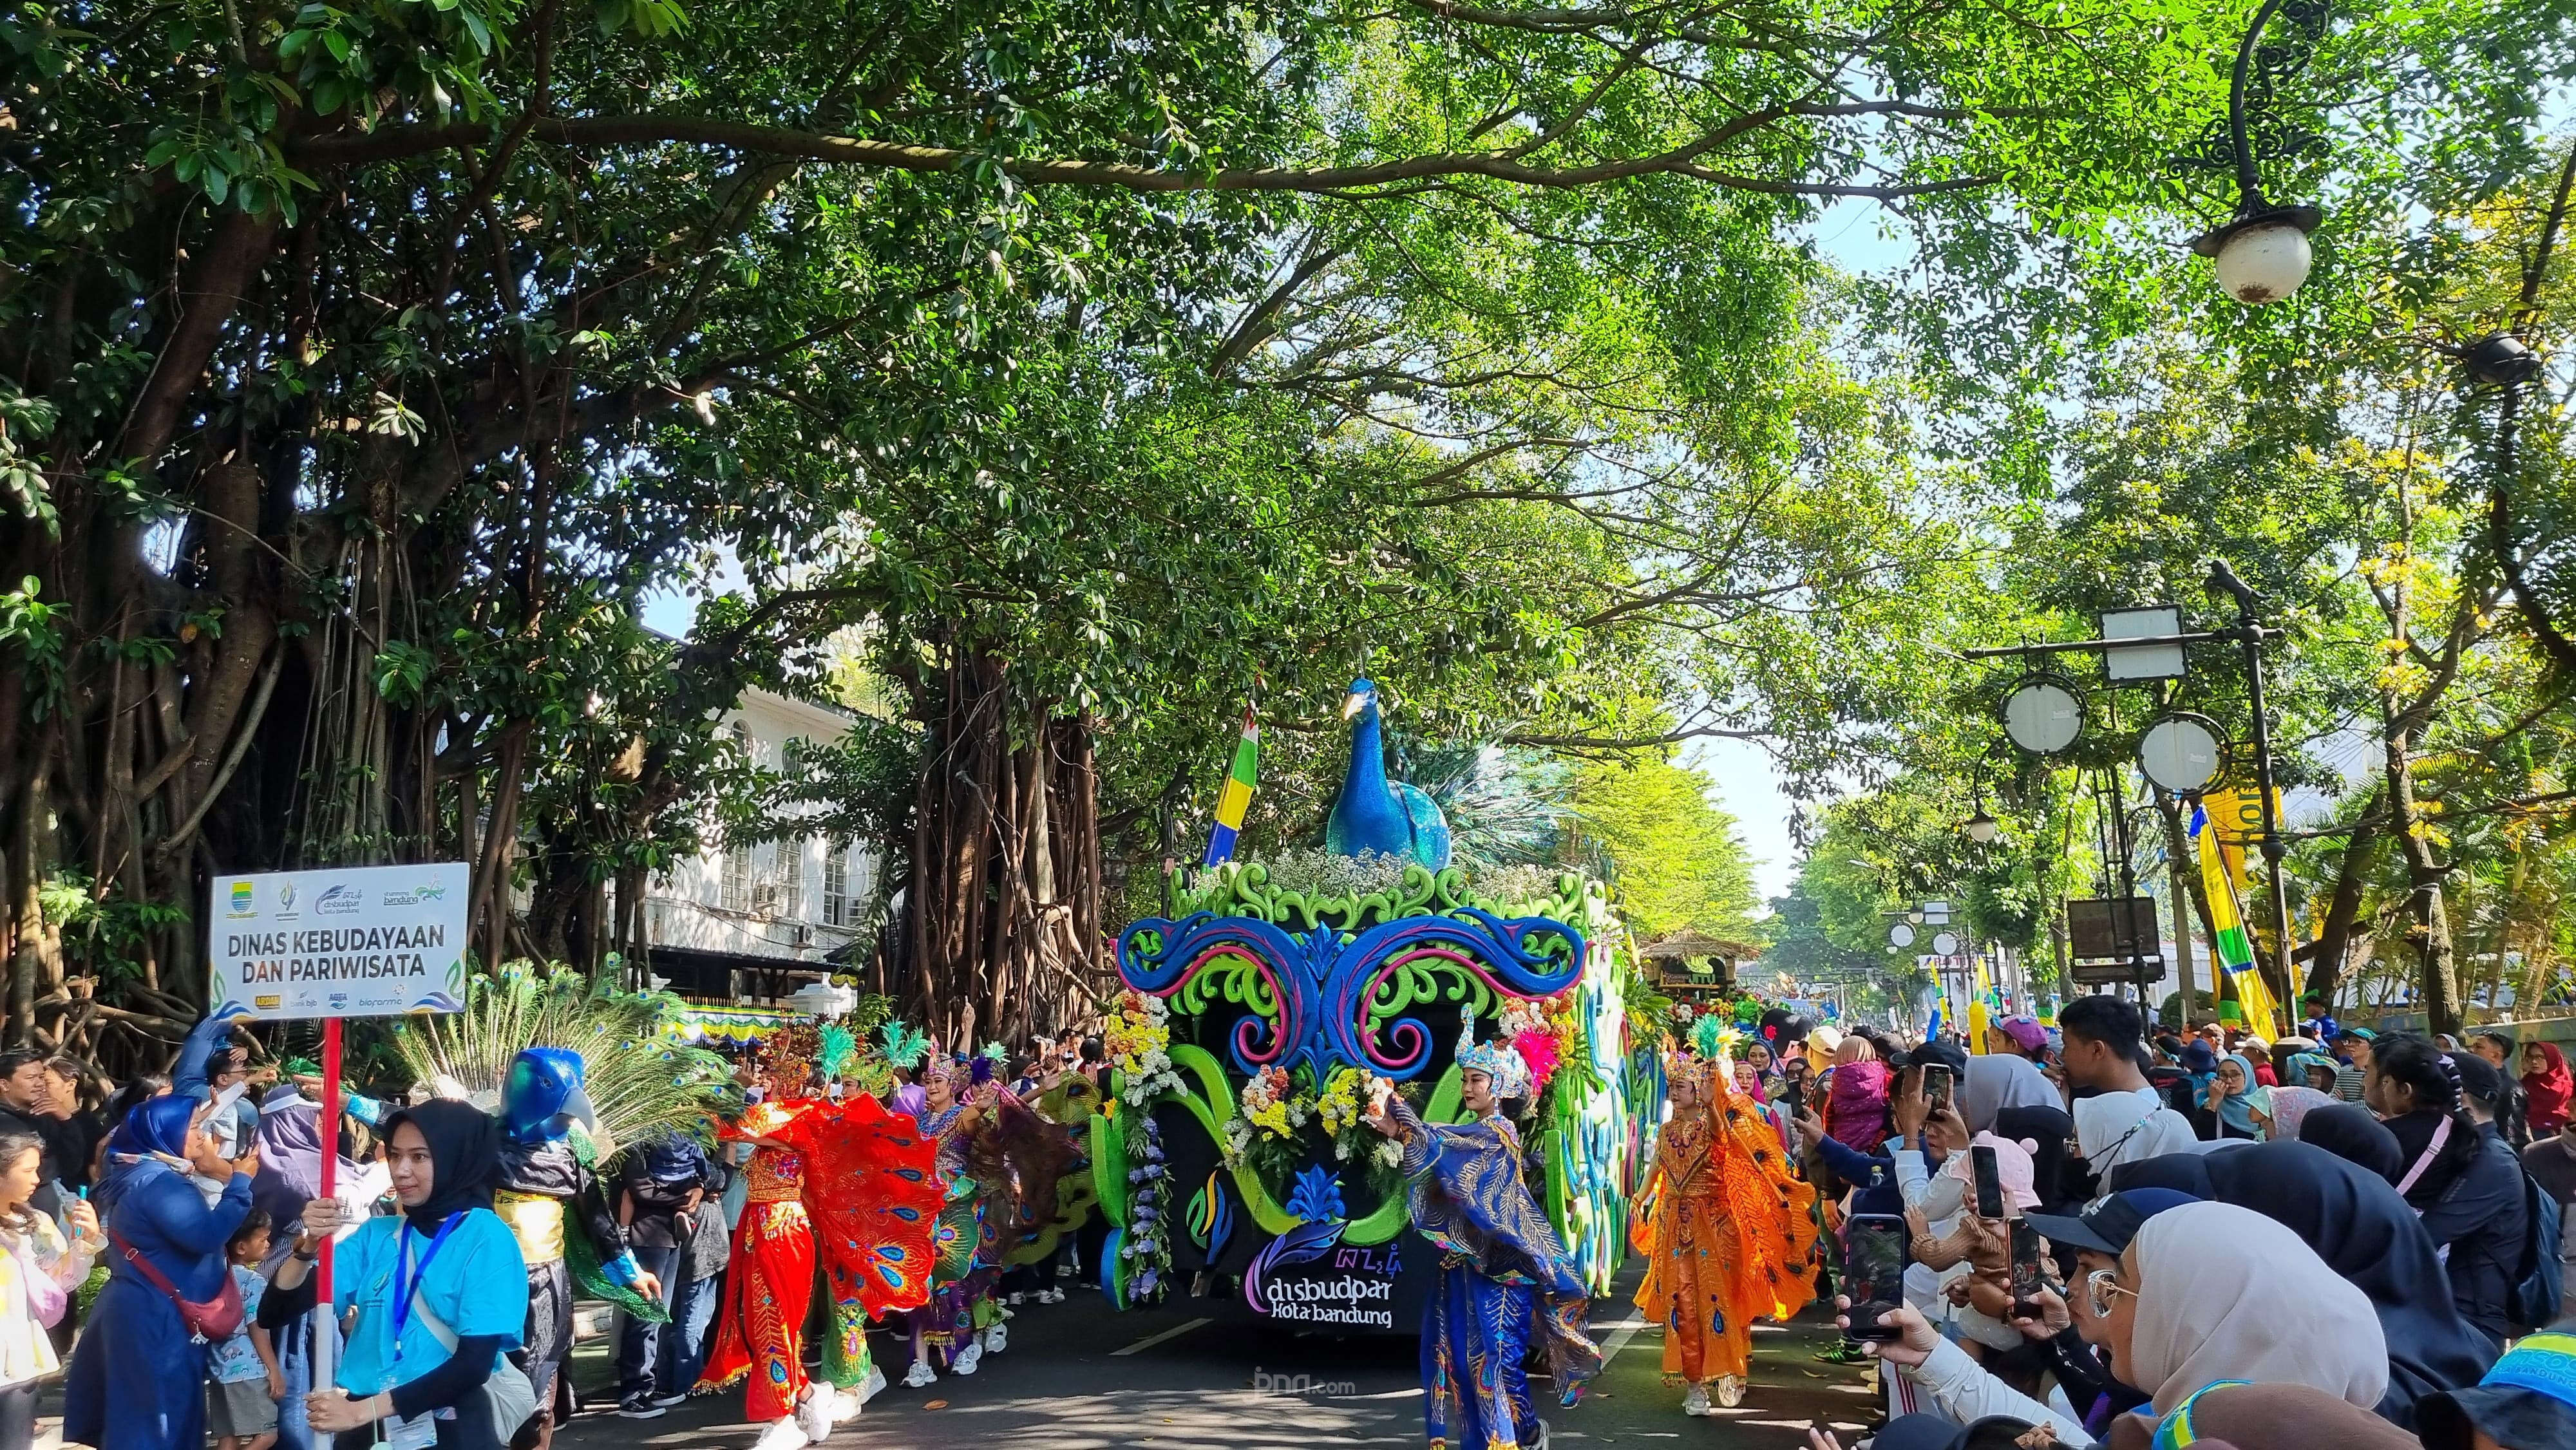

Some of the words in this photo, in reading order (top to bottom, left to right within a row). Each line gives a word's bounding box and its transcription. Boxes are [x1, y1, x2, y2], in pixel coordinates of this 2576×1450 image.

[228, 932, 287, 957] DINAS
[293, 925, 445, 954] KEBUDAYAAN
[242, 959, 284, 983] DAN
[290, 953, 426, 982] PARIWISATA
[329, 993, 348, 1002] AQUA
[359, 999, 402, 1008] biofarma
[1267, 1275, 1392, 1304] disbudpar
[1312, 1304, 1392, 1328] bandung
